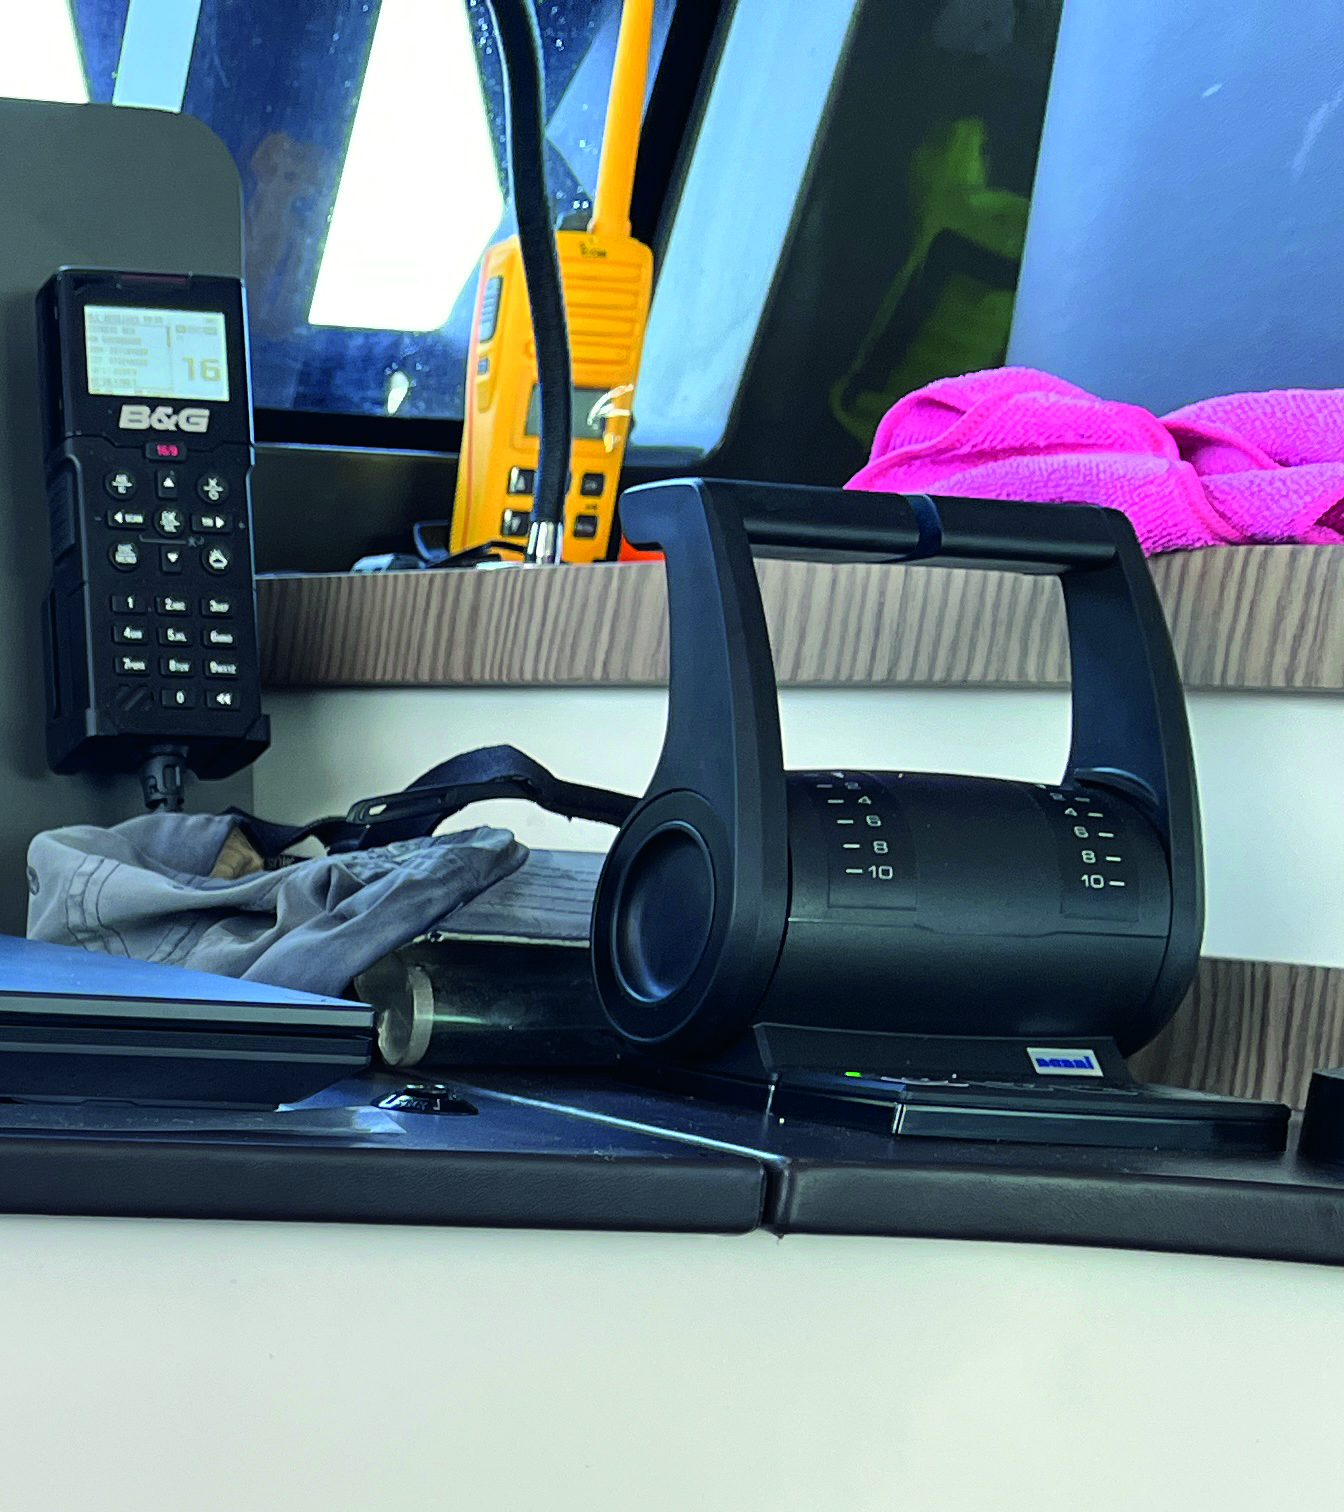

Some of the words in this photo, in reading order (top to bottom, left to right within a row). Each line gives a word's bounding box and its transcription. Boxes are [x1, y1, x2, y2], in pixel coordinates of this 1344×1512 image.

[181, 357, 221, 382] 16
[119, 404, 210, 433] B&G
[873, 840, 889, 854] 8
[1081, 850, 1096, 864] 8
[868, 865, 893, 880] 10
[1081, 874, 1105, 889] 10
